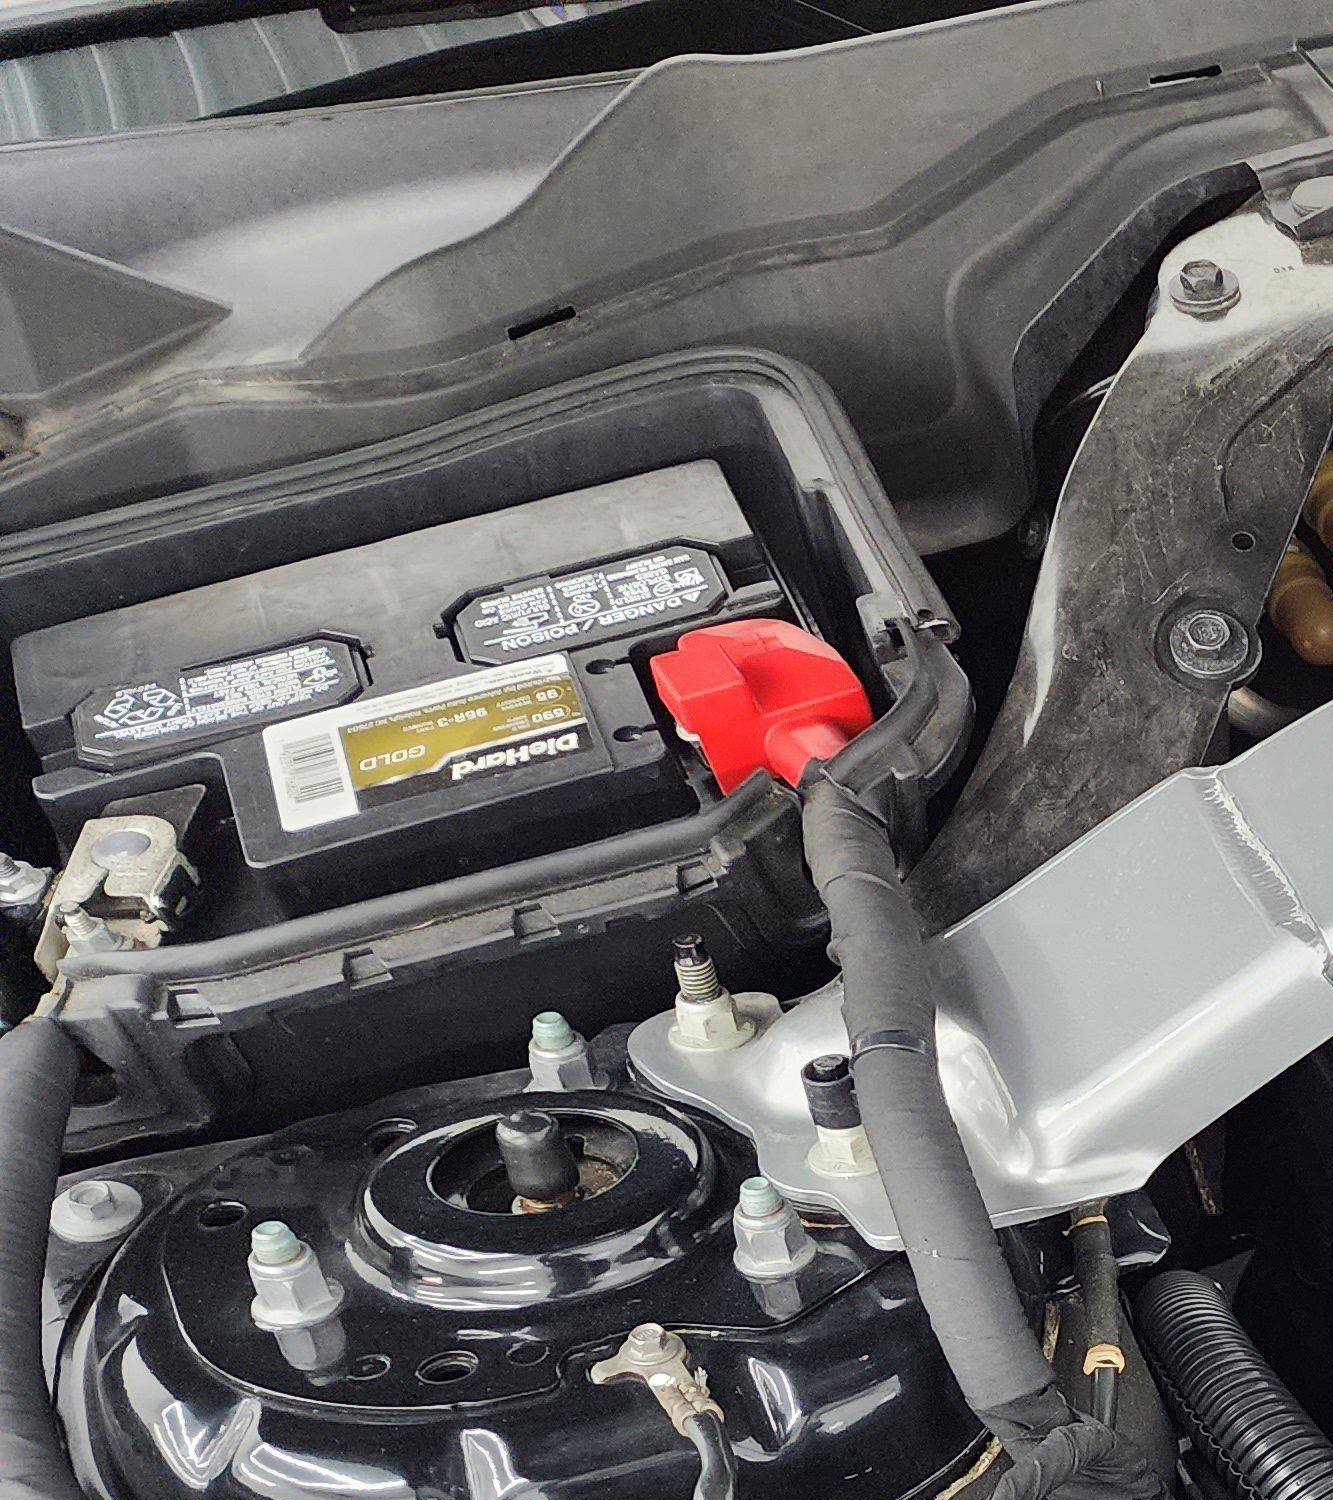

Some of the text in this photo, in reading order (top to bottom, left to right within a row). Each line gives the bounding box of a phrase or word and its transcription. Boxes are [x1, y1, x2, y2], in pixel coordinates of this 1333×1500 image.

[597, 593, 682, 625] DANGER
[500, 620, 579, 651] POISON
[534, 687, 559, 703] 95
[435, 705, 488, 728] 96R-3
[530, 706, 565, 724] 590
[356, 743, 427, 772] GOLD
[448, 731, 581, 780] DieHard
